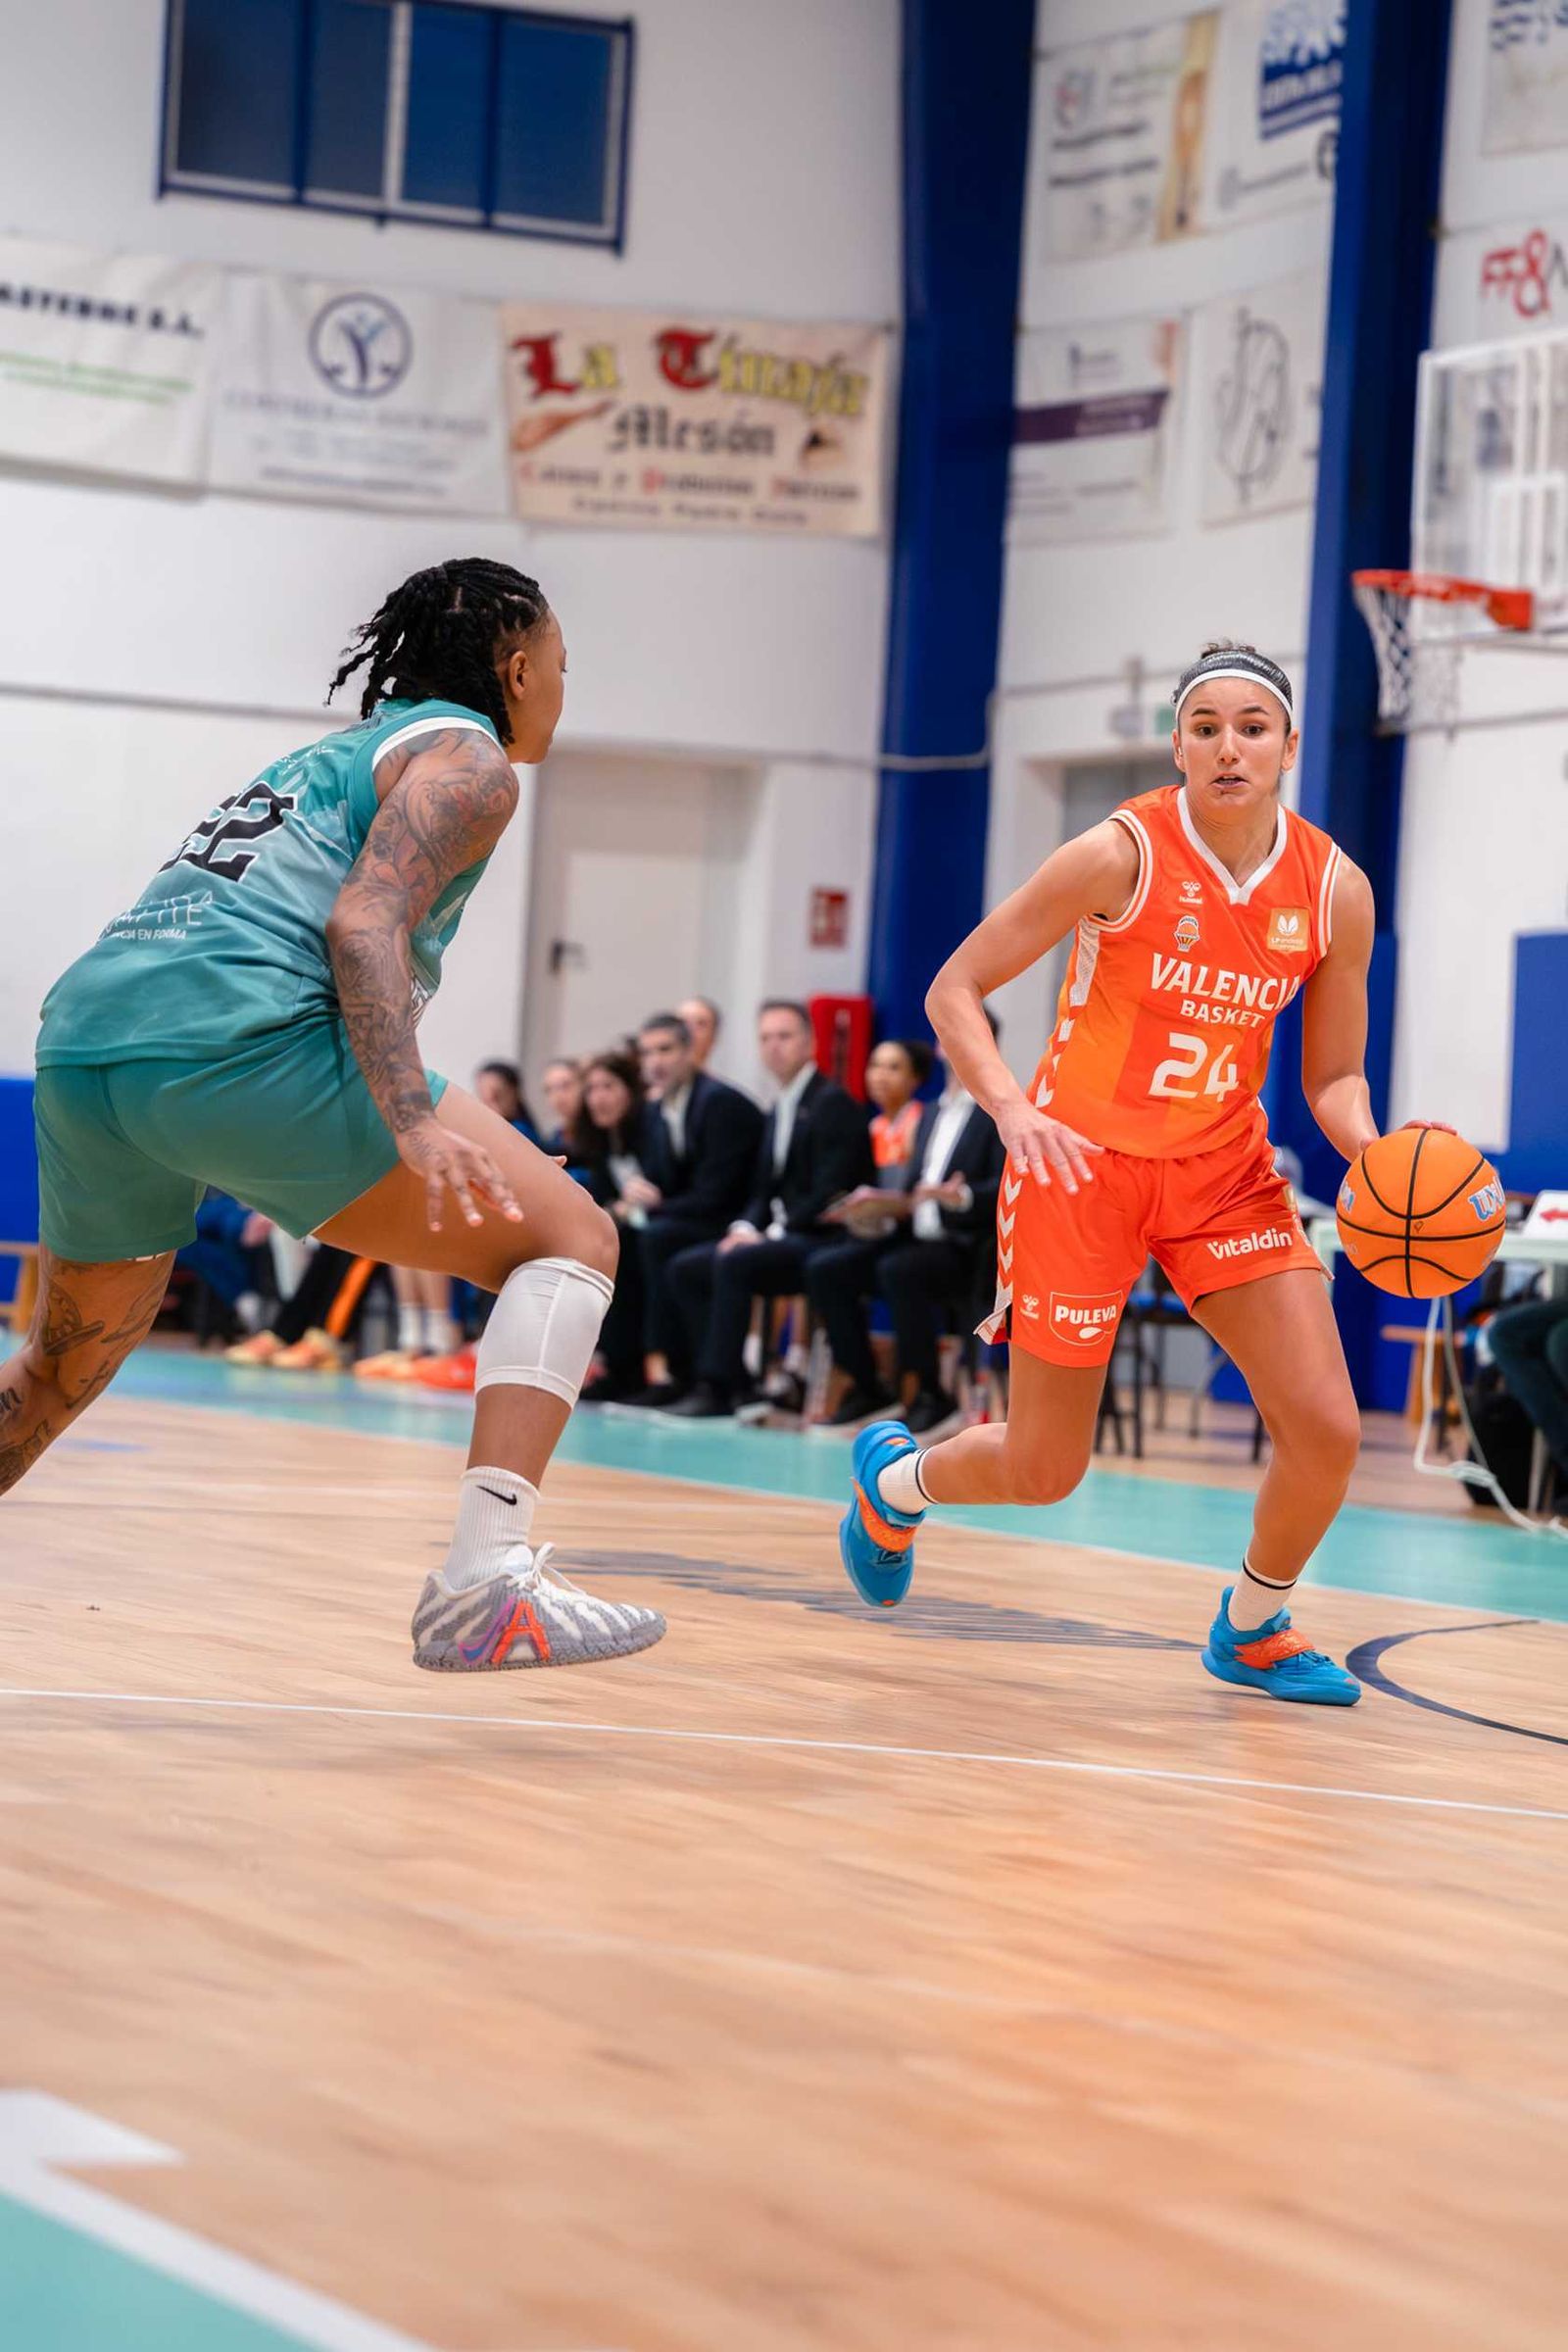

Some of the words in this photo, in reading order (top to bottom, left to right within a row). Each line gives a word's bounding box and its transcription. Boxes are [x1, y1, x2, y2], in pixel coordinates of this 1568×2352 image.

[512, 331, 619, 400] La
[607, 402, 776, 457] Mesón
[1151, 952, 1300, 1011] VALENCIA
[1180, 1000, 1265, 1028] BASKET
[1148, 1032, 1239, 1102] 24
[1207, 1228, 1293, 1260] Vitaldin
[1054, 1304, 1117, 1325] PULEVA
